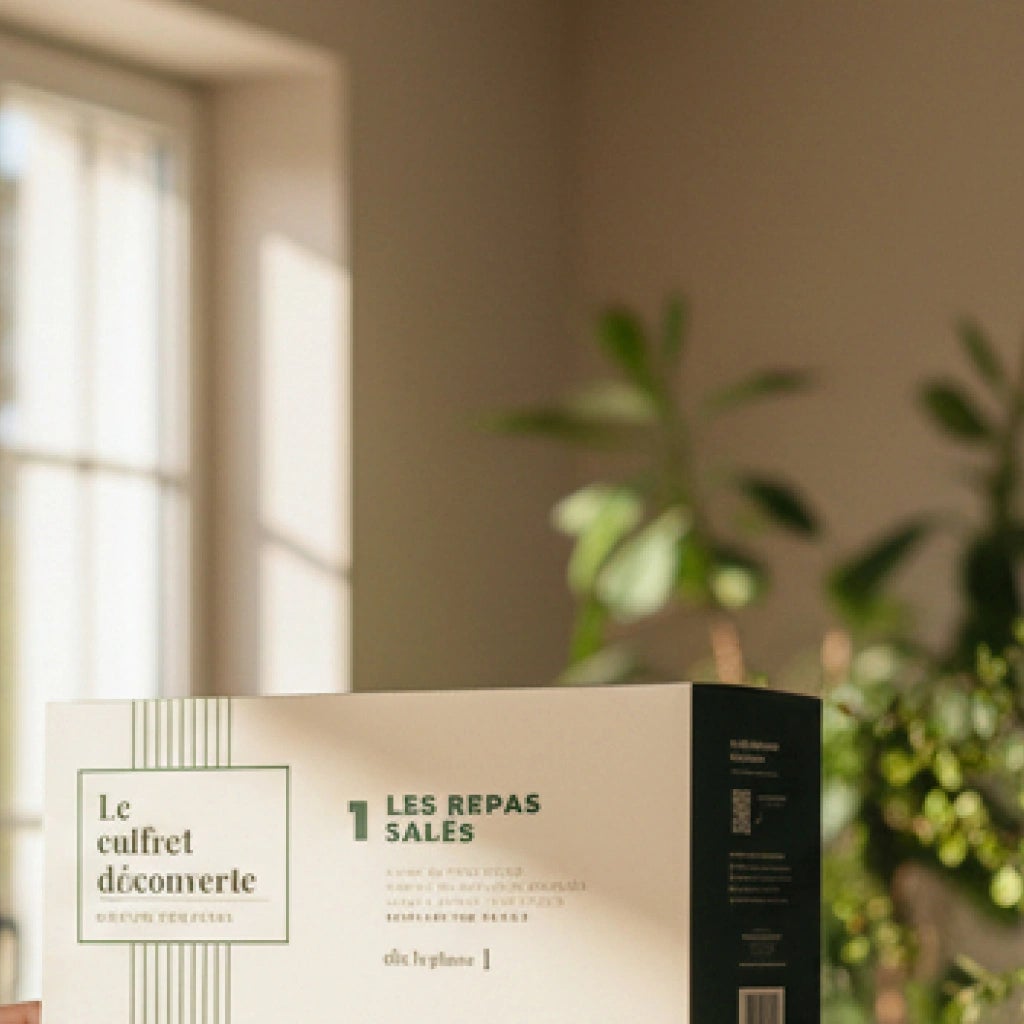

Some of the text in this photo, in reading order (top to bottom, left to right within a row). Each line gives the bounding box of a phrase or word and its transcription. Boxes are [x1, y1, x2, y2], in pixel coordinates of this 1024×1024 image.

[99, 793, 131, 822] Le
[387, 793, 541, 816] LES REPAS
[347, 799, 368, 842] 1
